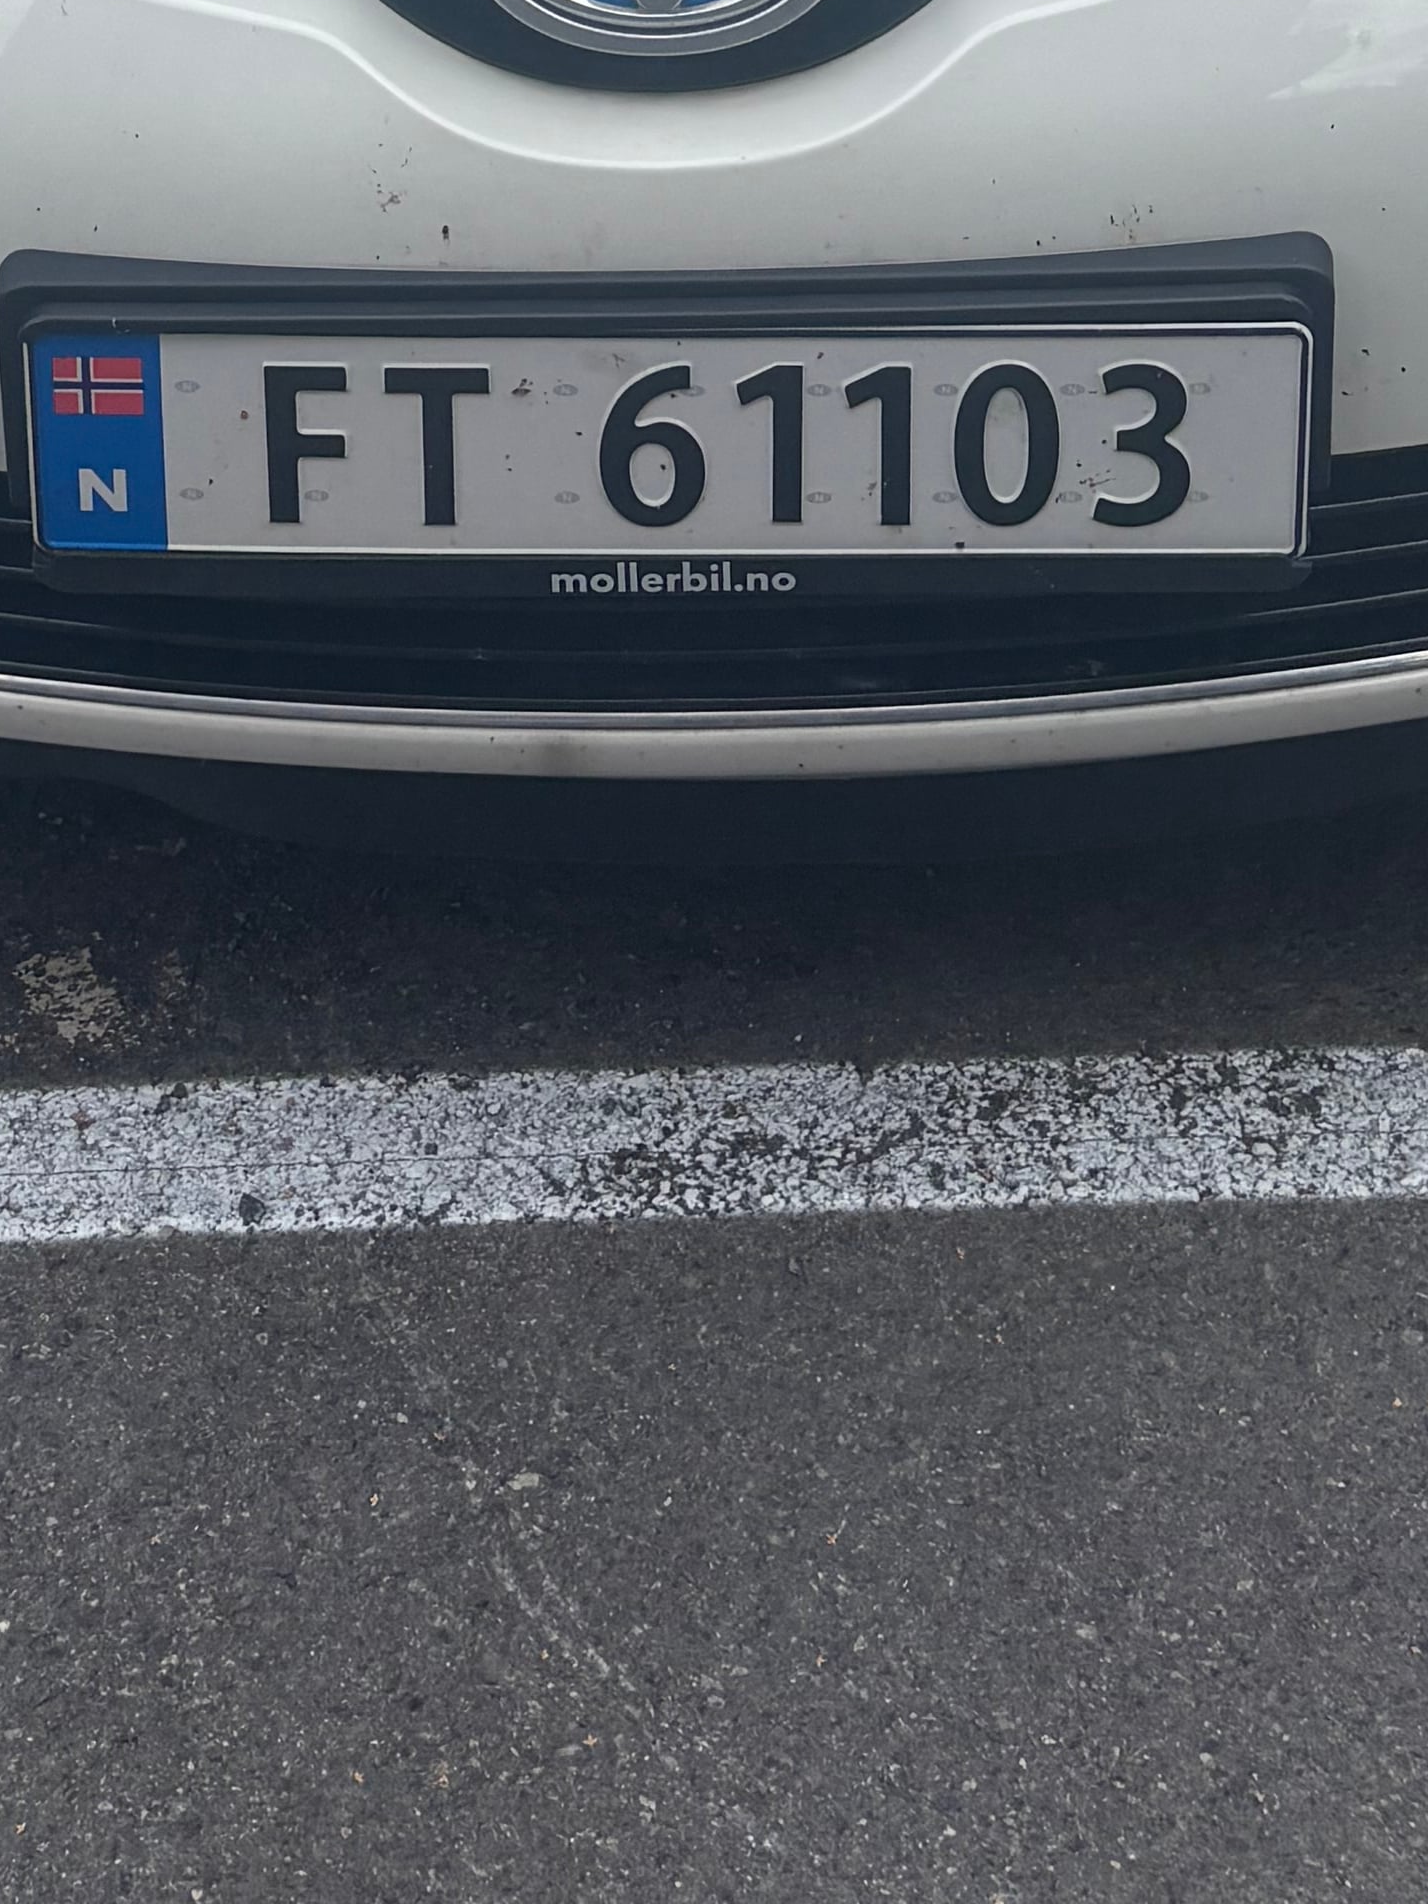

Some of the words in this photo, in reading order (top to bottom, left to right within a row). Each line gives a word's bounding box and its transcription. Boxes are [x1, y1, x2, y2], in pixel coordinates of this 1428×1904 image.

[263, 363, 491, 526] FT
[599, 361, 1192, 527] 61103
[78, 467, 128, 512] N
[550, 560, 798, 594] mollerbil.no
